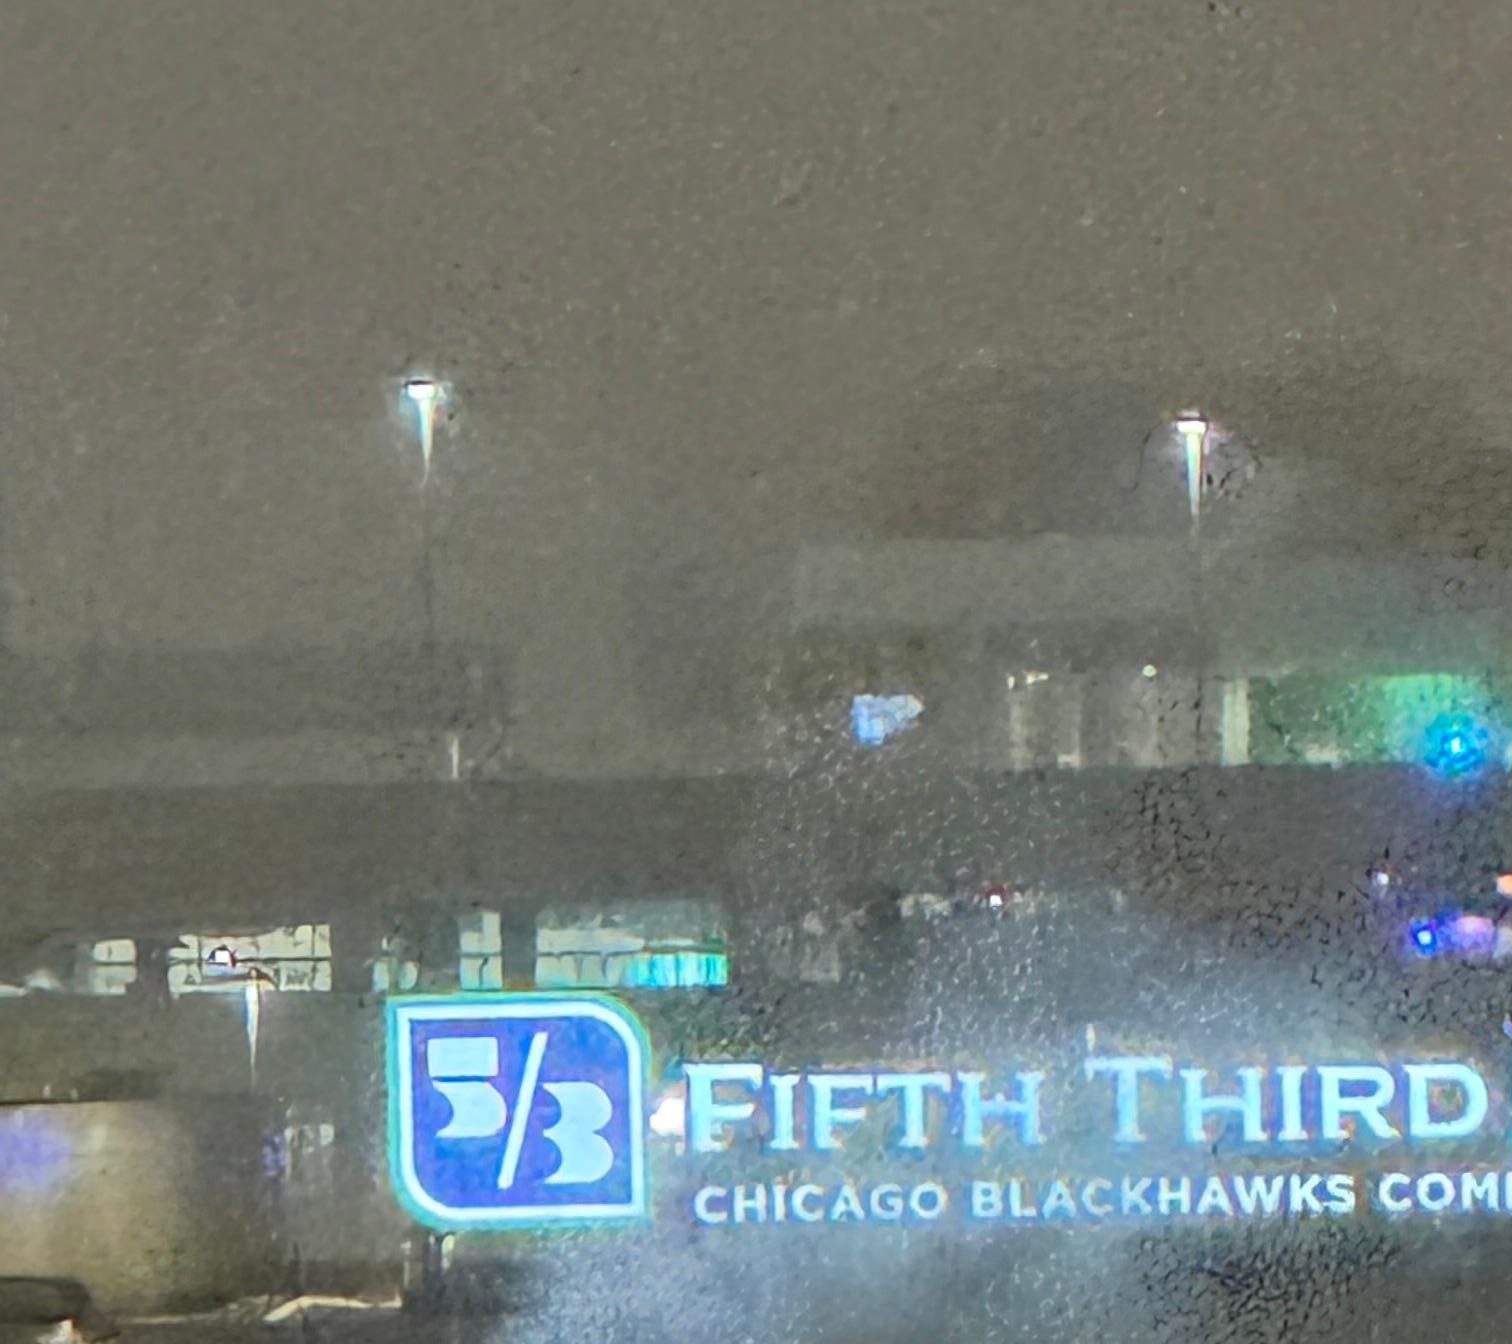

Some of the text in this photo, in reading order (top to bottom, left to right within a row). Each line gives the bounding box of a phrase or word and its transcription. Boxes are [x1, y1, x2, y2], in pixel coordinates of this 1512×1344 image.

[682, 1062, 1047, 1152] FIFTH
[1084, 1054, 1489, 1143] THIRD
[693, 1180, 948, 1224] CHICAGO
[970, 1172, 1356, 1221] BLACKHAWKS
